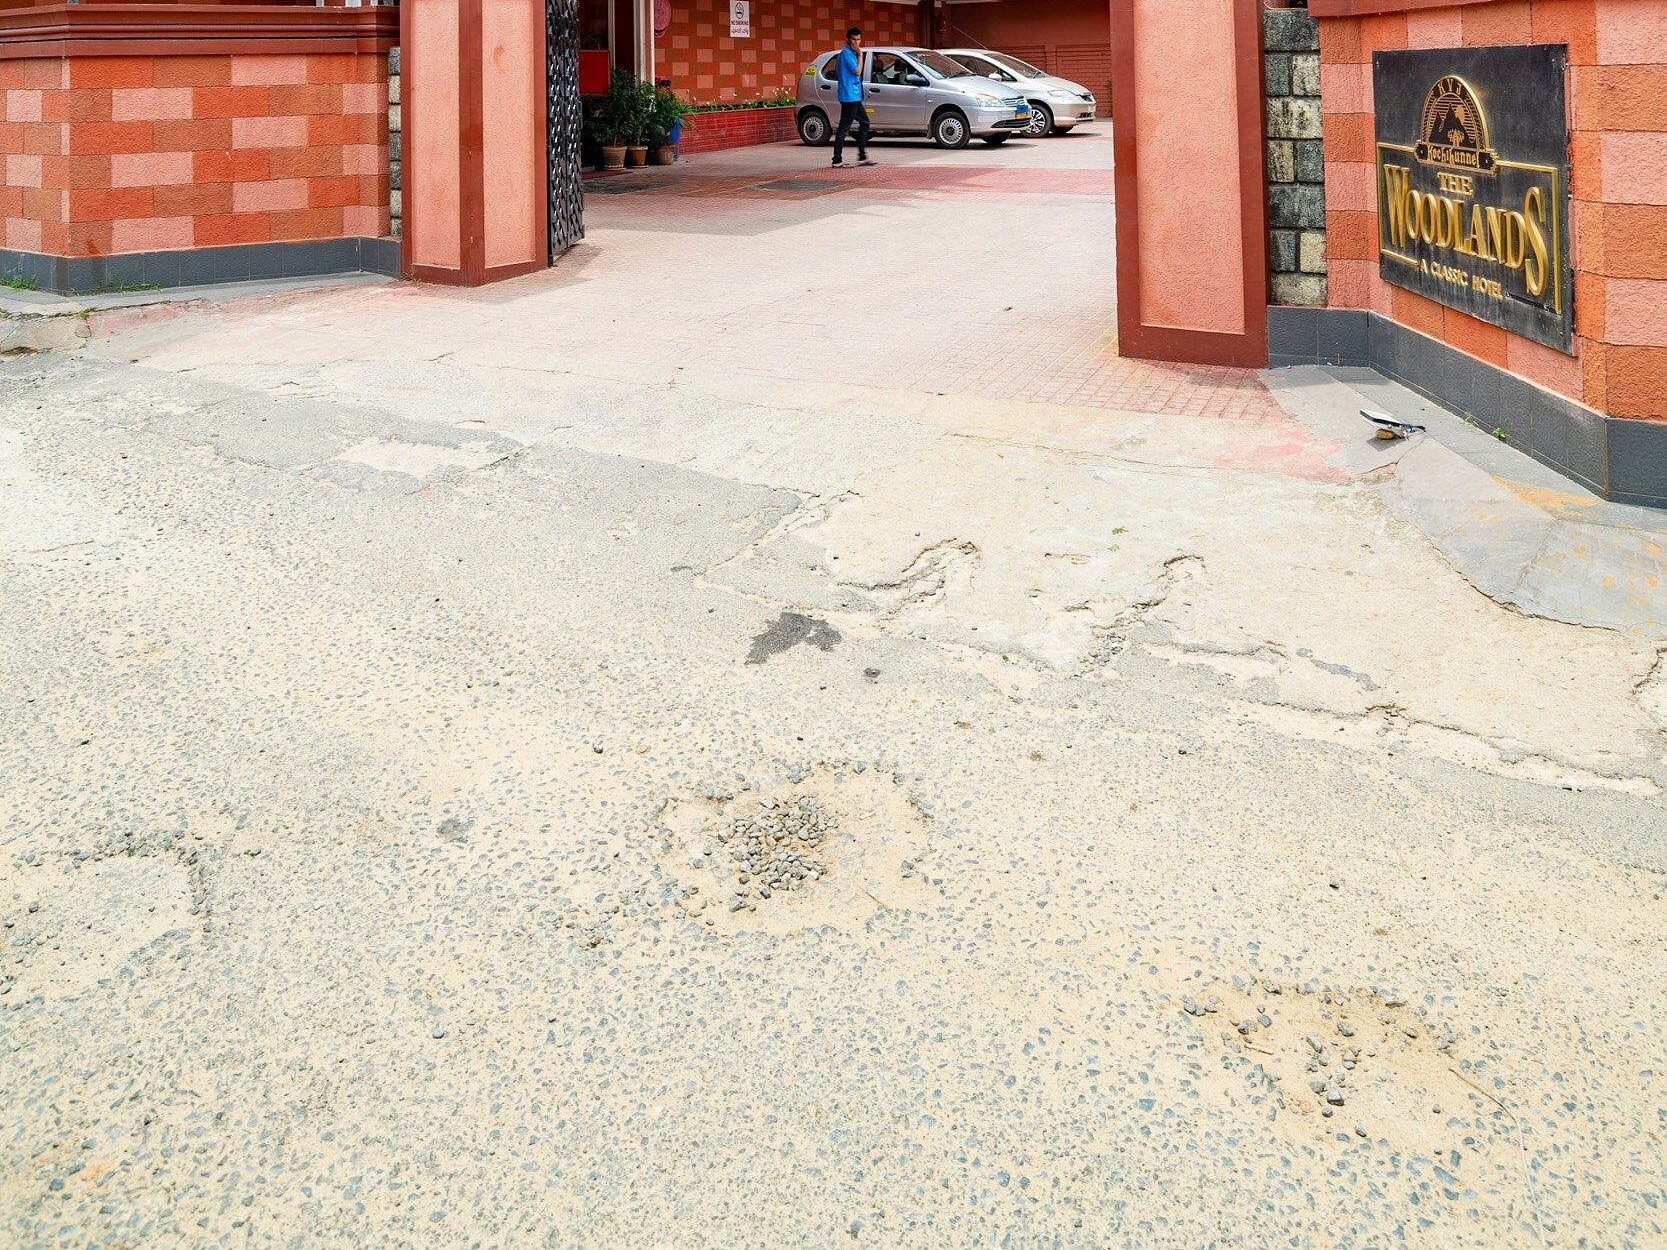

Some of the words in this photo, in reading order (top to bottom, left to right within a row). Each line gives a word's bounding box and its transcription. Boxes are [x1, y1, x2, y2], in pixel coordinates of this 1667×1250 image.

[1437, 171, 1474, 197] THE
[1384, 164, 1547, 296] WOODLANDS
[1420, 259, 1428, 274] A
[1431, 261, 1469, 287] CLASSIC
[1471, 275, 1504, 299] HOTEL
